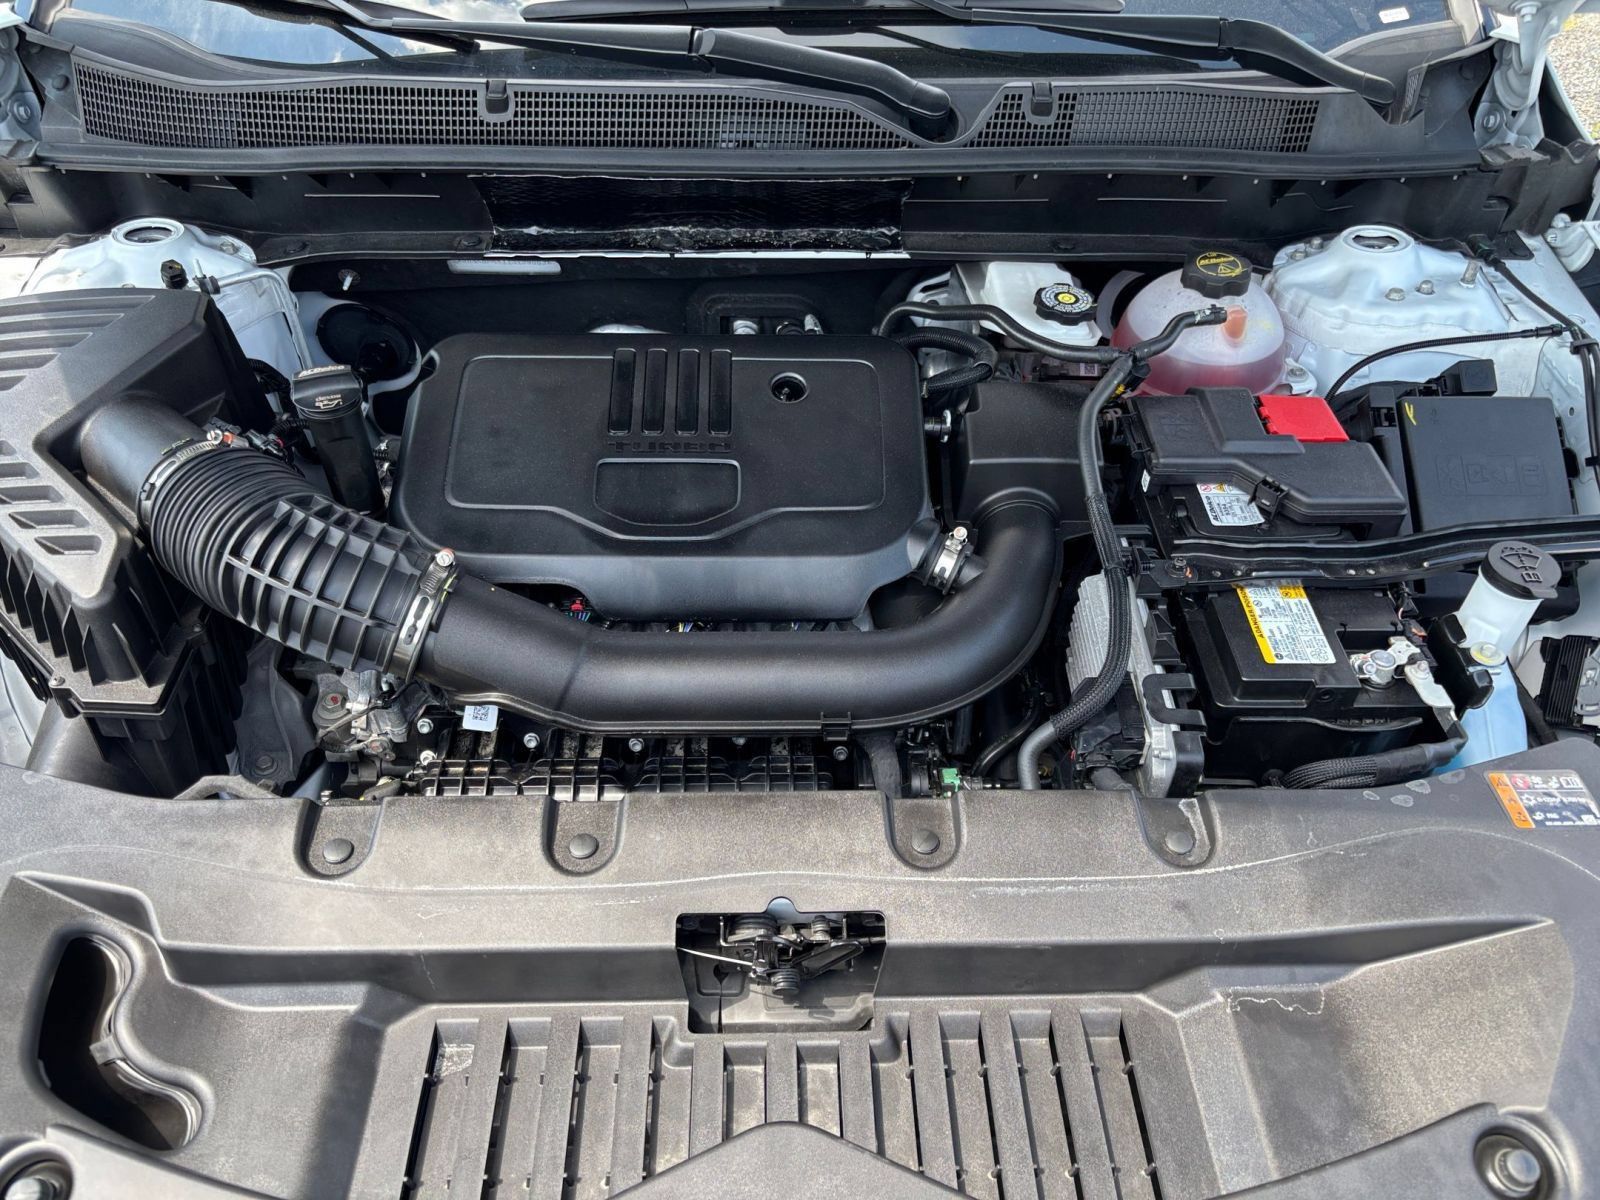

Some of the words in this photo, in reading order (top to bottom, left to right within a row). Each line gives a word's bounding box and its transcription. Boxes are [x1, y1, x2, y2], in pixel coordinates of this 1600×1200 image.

[298, 365, 345, 378] ACDelco
[607, 441, 734, 454] TURBO
[1205, 496, 1220, 522] ACDelco
